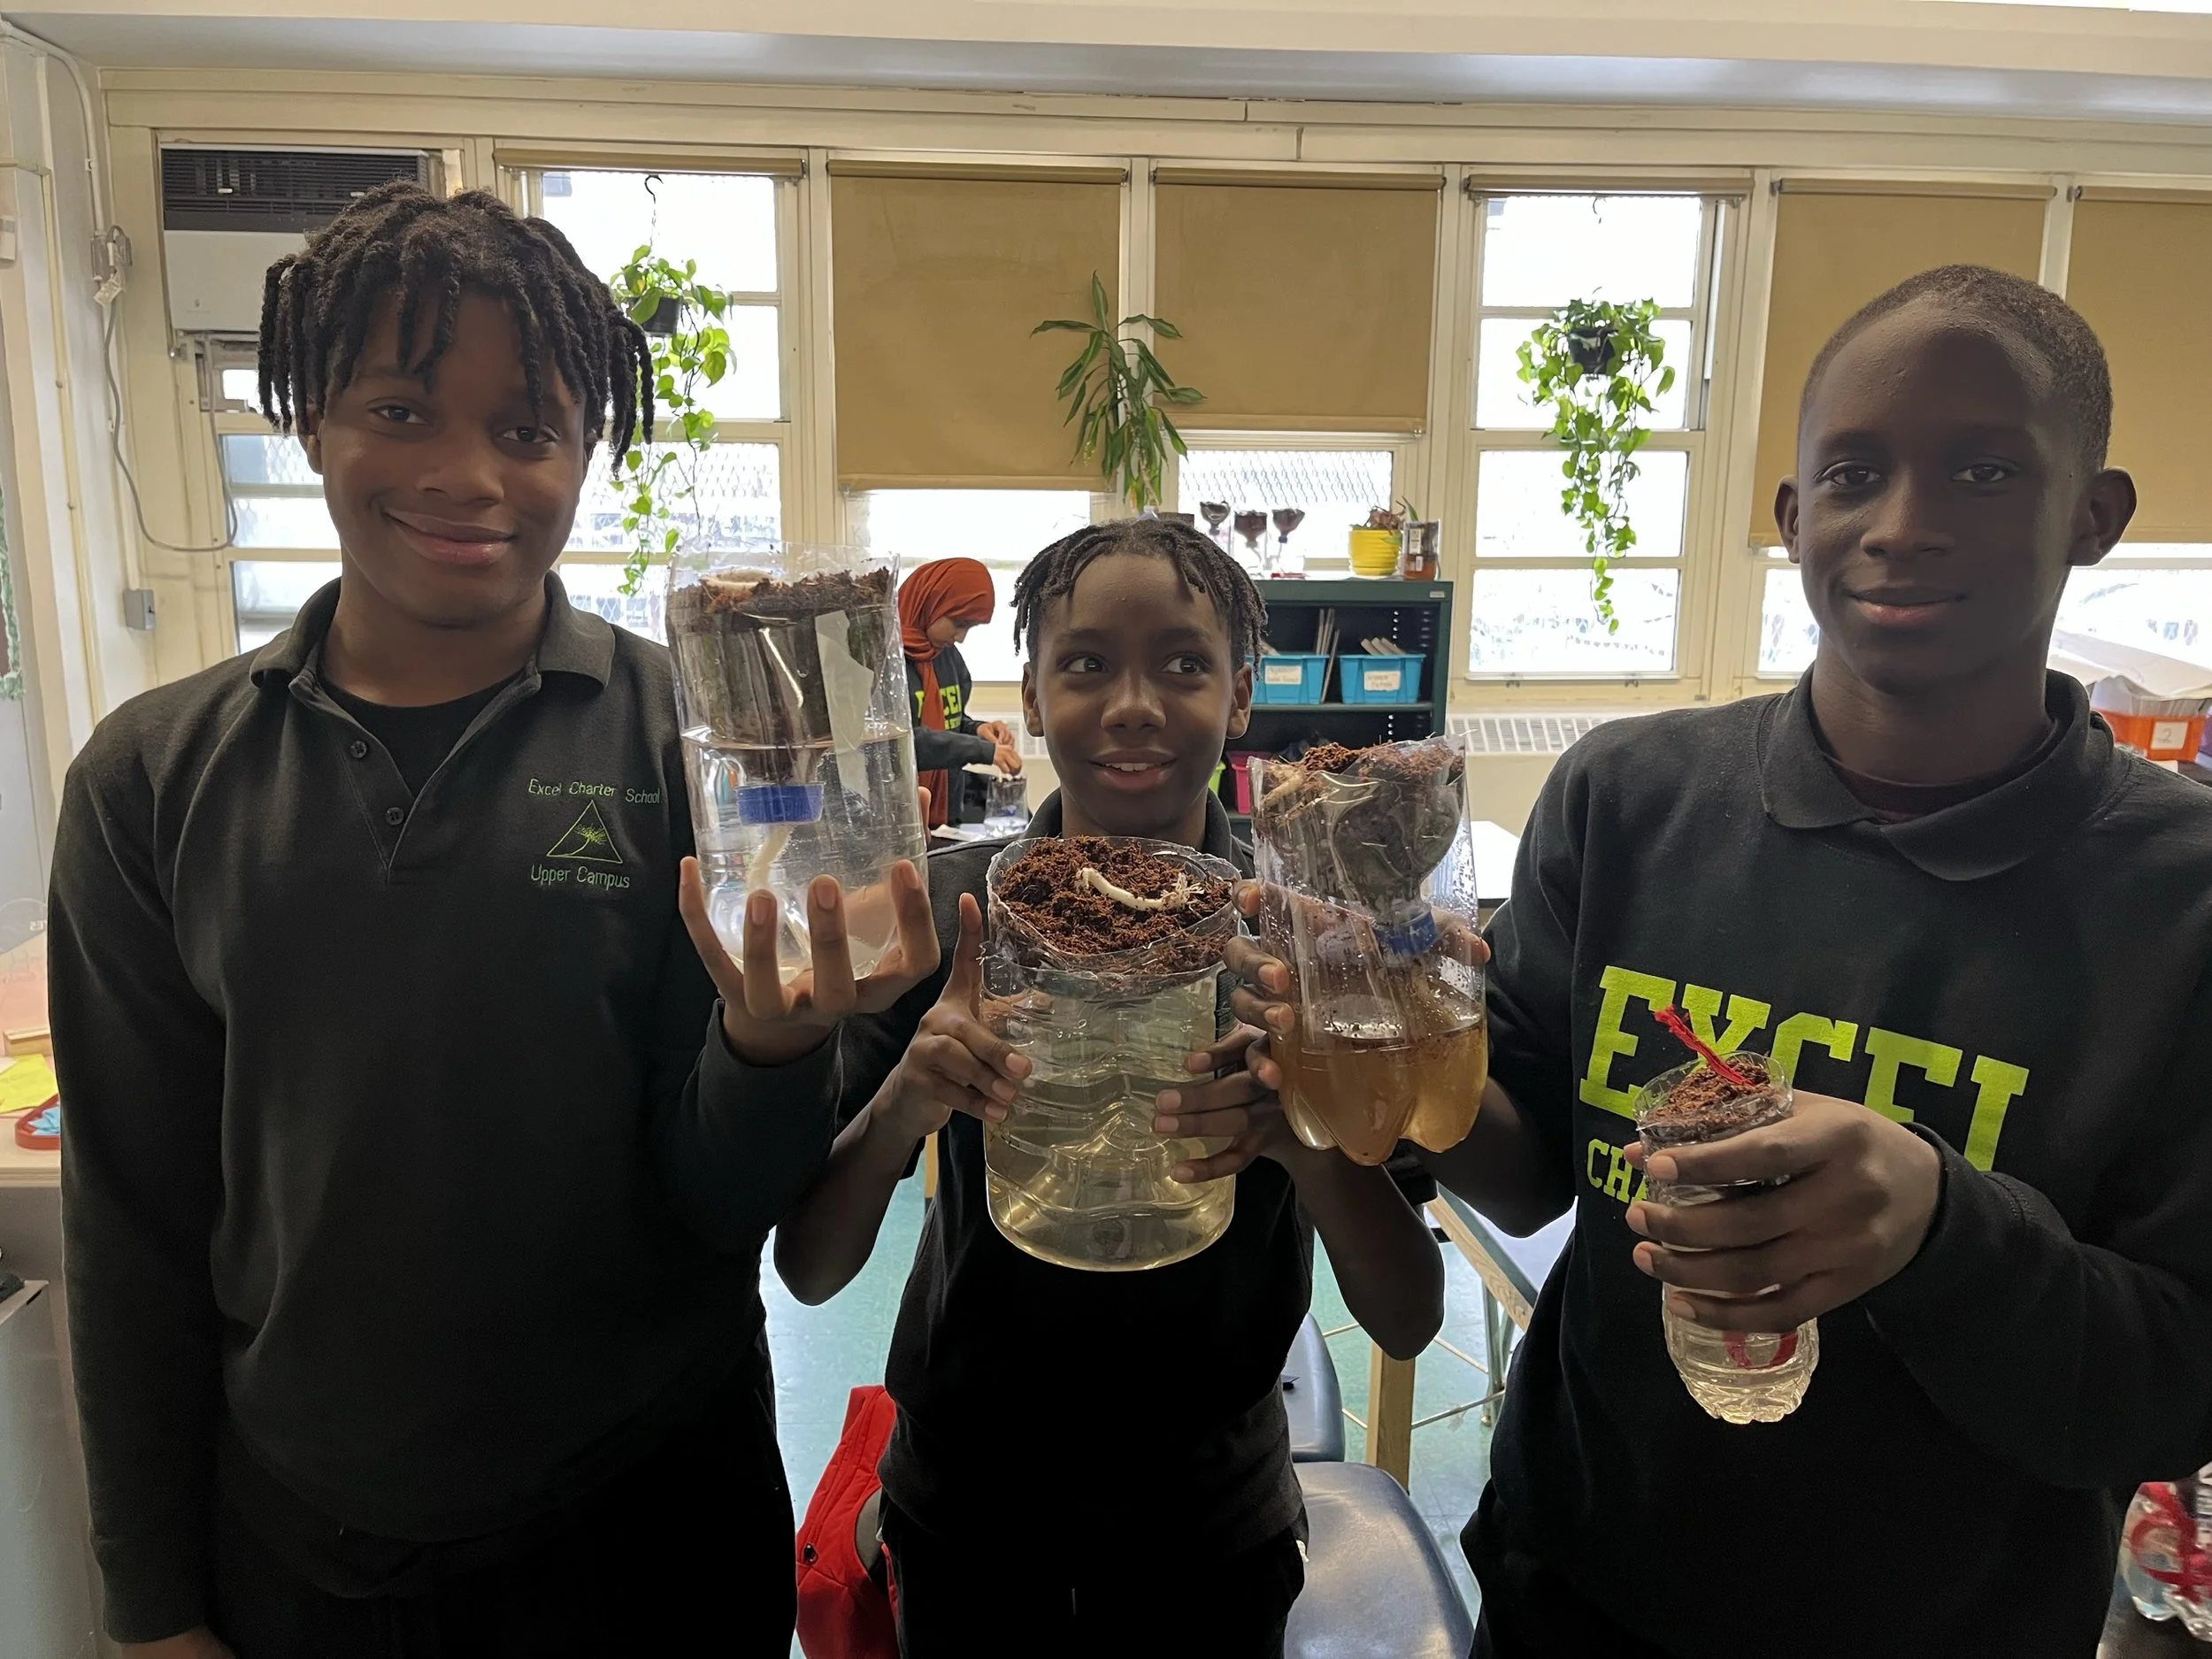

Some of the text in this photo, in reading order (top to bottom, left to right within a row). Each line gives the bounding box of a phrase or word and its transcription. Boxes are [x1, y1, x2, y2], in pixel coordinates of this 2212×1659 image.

[528, 778, 661, 804] Excel Charter School
[531, 864, 630, 890] Upper Campus
